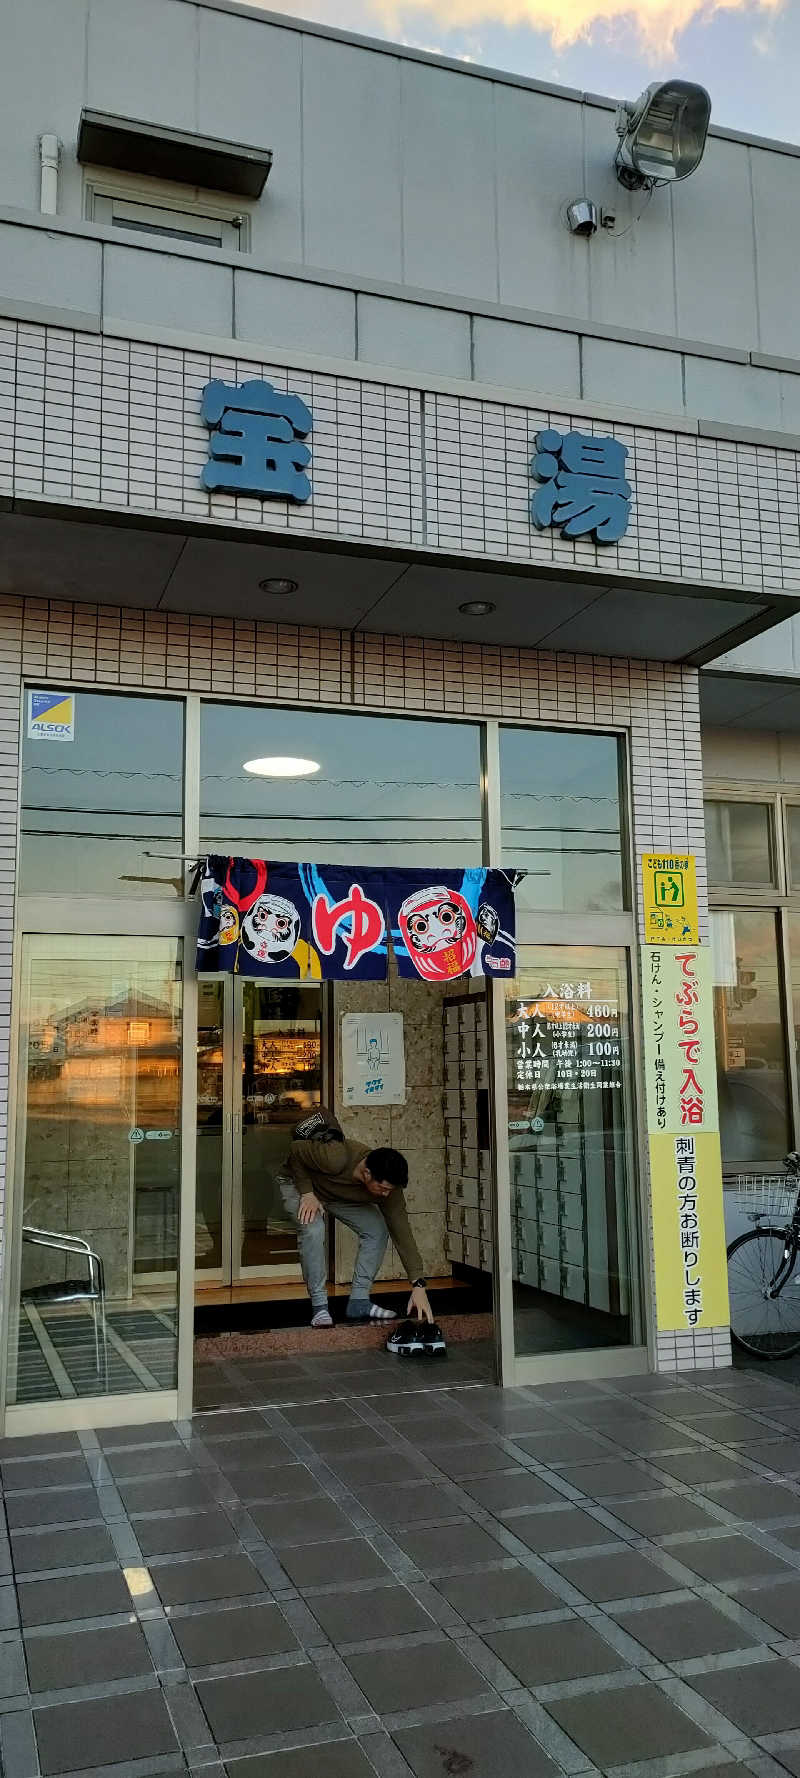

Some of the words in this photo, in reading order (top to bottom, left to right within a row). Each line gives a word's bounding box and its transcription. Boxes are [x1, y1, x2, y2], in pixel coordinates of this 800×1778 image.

[31, 723, 71, 733] ALSOK
[312, 883, 385, 970] ゆ
[543, 982, 592, 999] 入浴料
[517, 1003, 546, 1019] 大人
[517, 1022, 546, 1039] 中人
[674, 952, 704, 1126] てぶらで入浴
[517, 1042, 547, 1058] 小人
[516, 1070, 541, 1080] 定休日
[675, 1137, 703, 1326] 刺青の方お断りします
